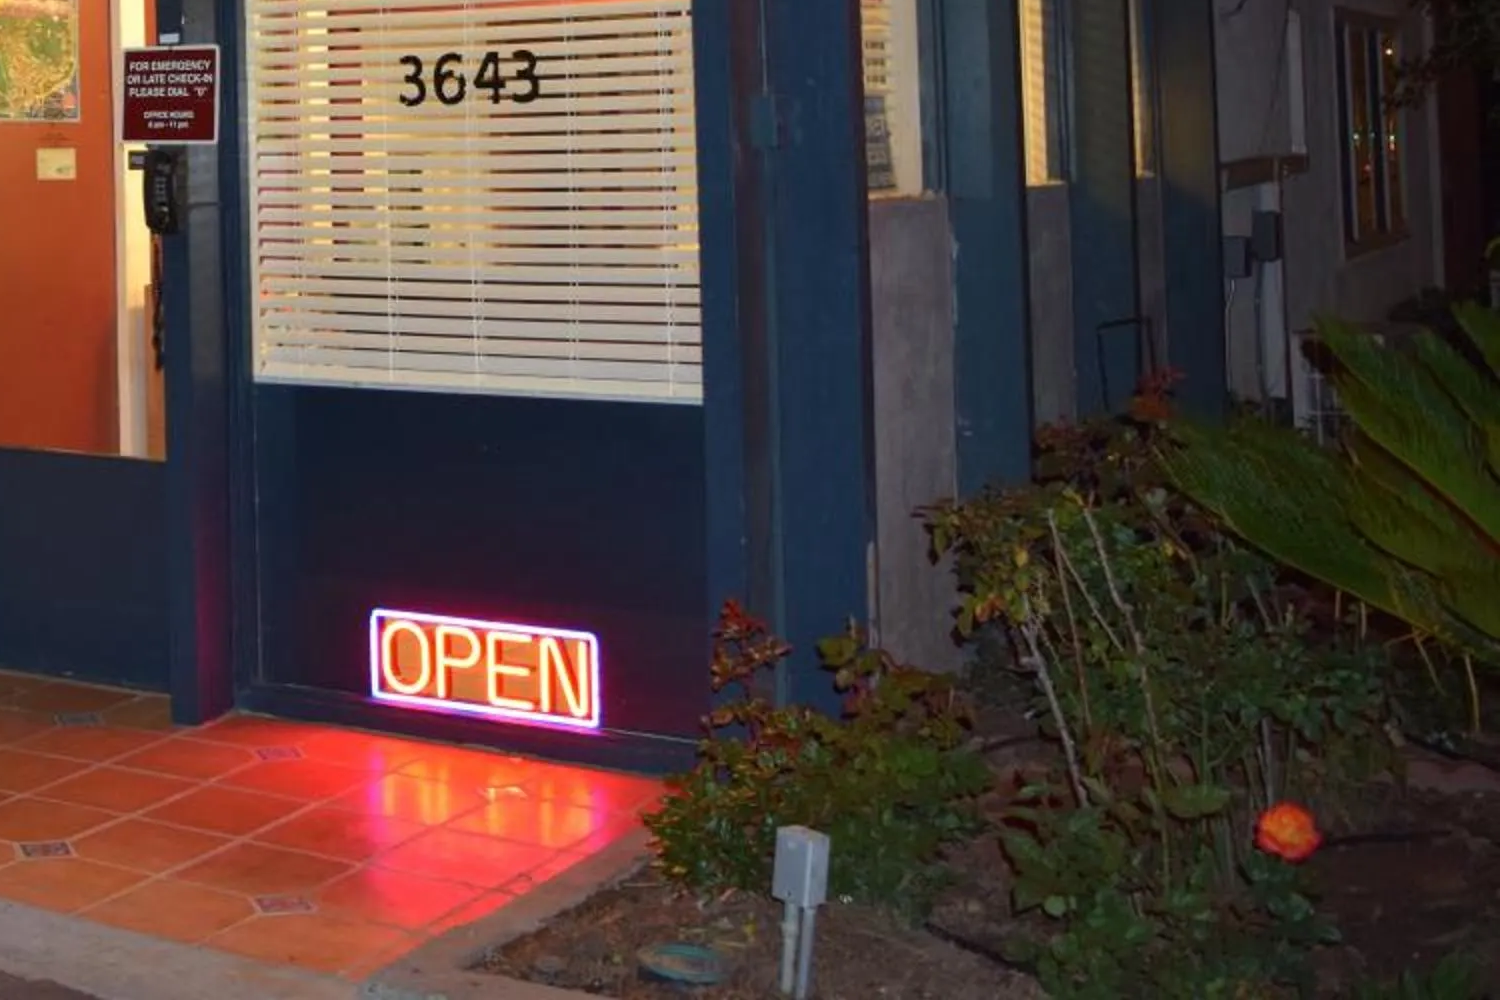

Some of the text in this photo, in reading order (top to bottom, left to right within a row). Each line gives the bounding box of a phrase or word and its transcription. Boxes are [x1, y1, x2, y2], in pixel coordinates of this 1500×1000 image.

[129, 60, 211, 72] FOR EMERGENCY
[127, 73, 213, 85] OR LATE CHECK-IN
[399, 49, 540, 107] 3643
[129, 87, 166, 97] PLEASE
[167, 87, 190, 97] DIAL
[381, 619, 588, 718] OPEN
